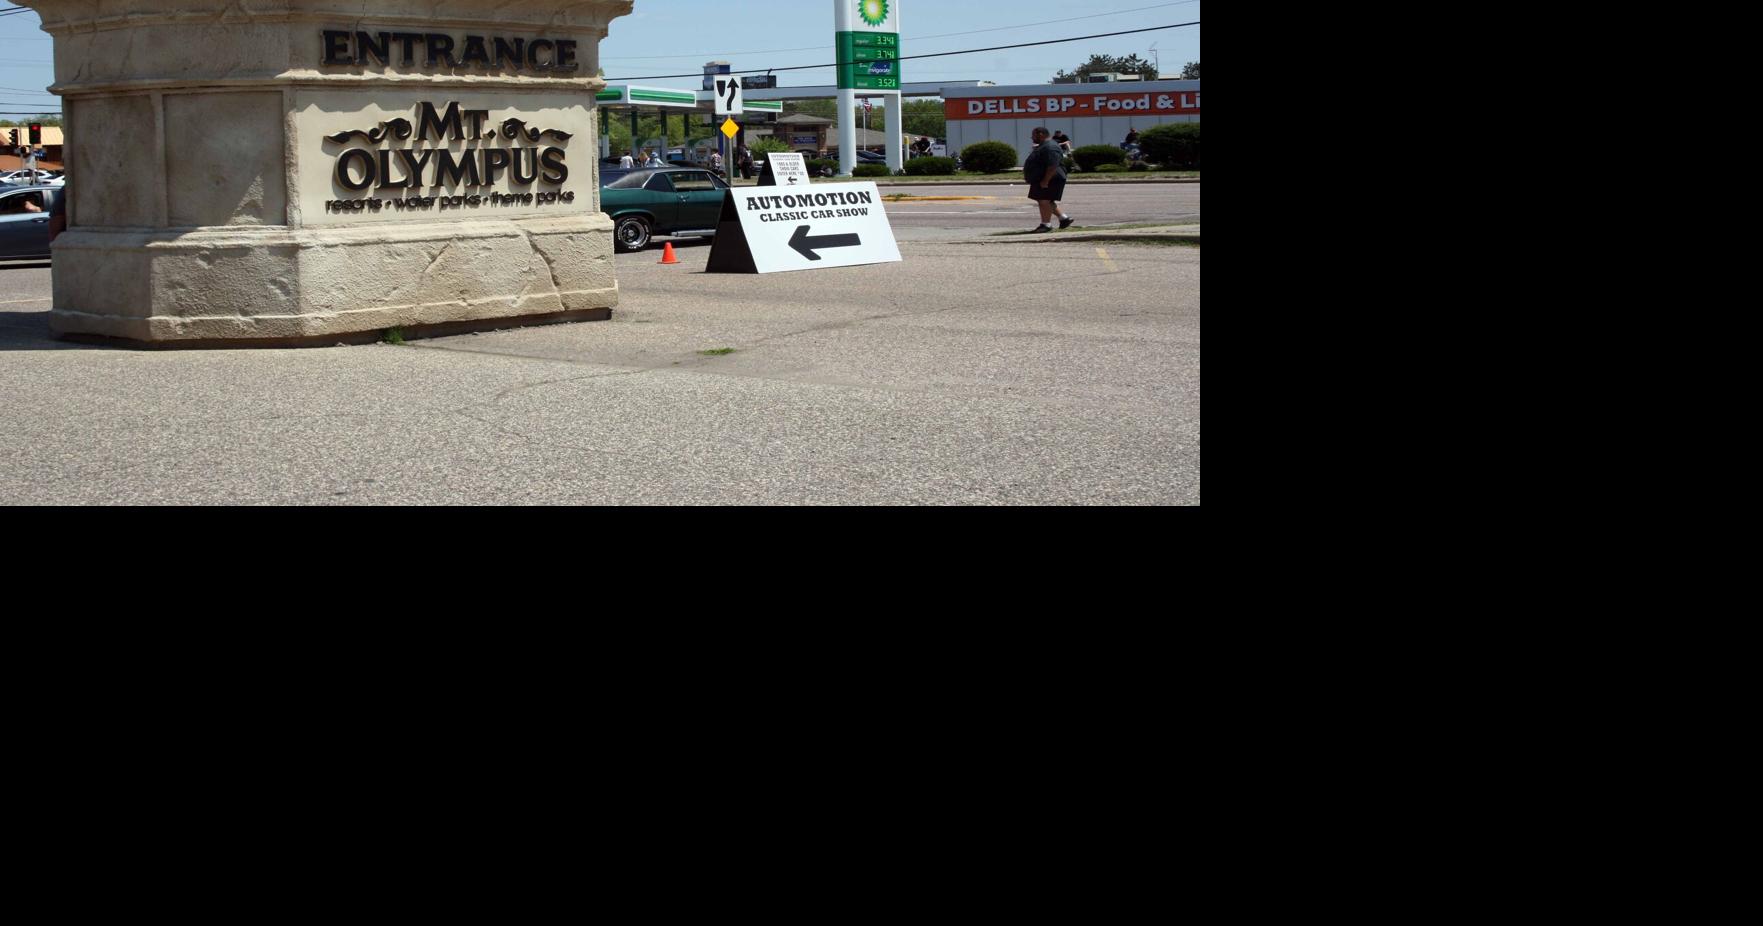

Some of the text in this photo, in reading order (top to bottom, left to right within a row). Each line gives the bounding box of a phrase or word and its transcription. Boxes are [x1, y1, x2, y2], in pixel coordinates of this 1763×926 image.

[321, 30, 579, 71] ENTRANCE
[968, 99, 1041, 115] DELLS
[1046, 98, 1076, 113] BP
[1093, 94, 1150, 111] Food
[1156, 95, 1175, 109] &
[335, 146, 569, 191] OLYMPUS
[325, 188, 575, 213] resorts water parks theme parks
[746, 191, 872, 211] AUTOMOTION
[760, 207, 868, 222] CLASSIC CAR SHOW
